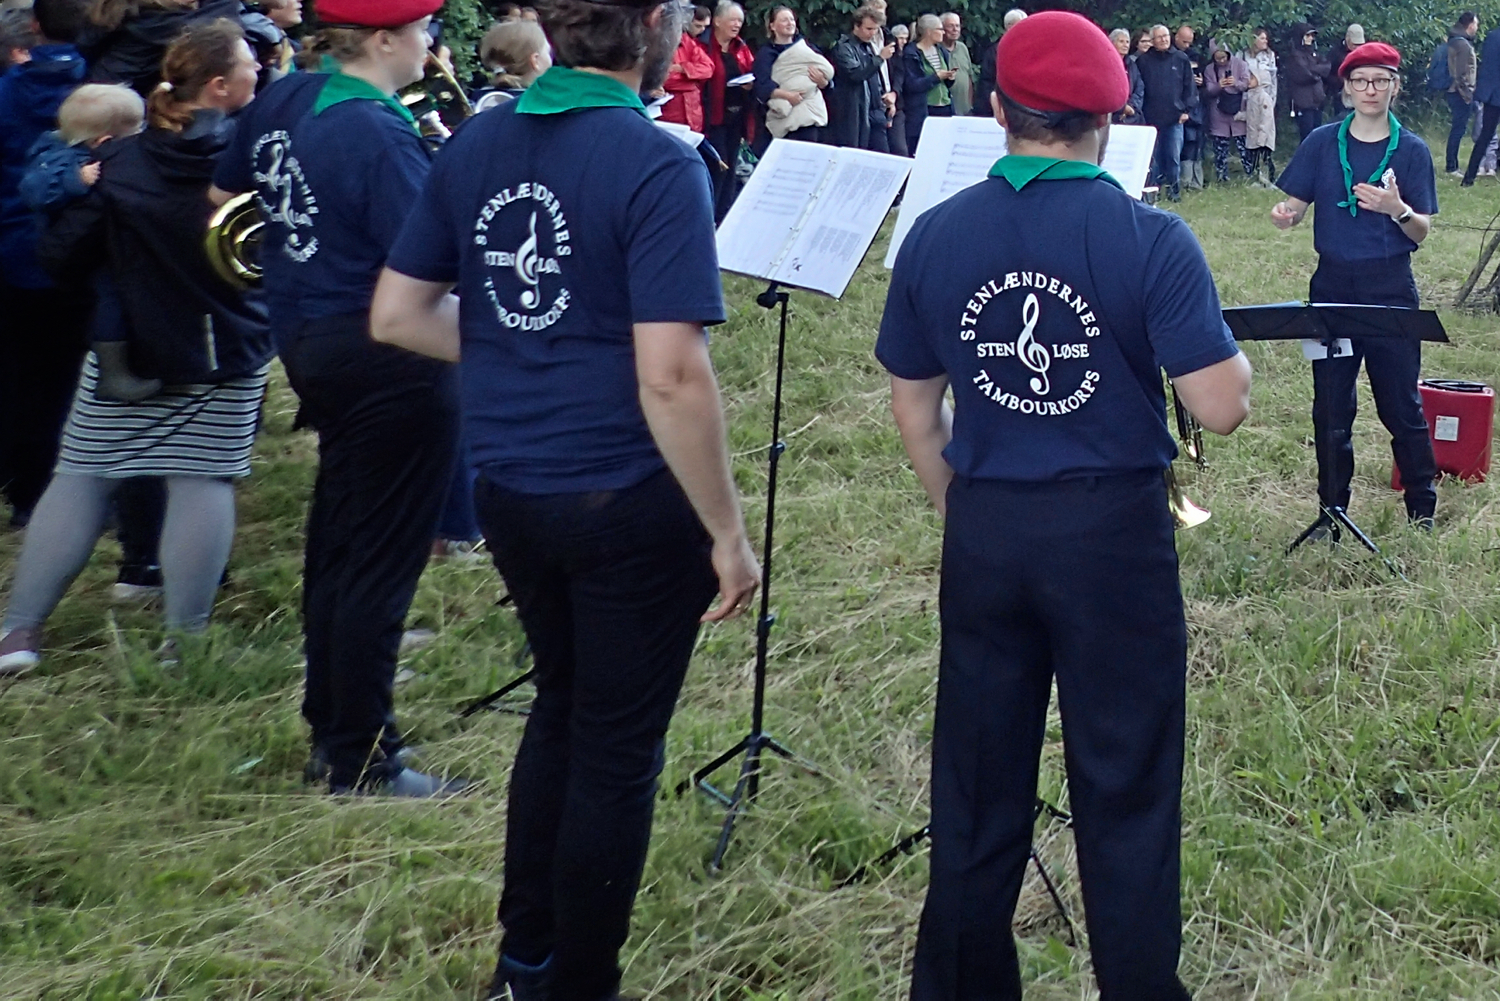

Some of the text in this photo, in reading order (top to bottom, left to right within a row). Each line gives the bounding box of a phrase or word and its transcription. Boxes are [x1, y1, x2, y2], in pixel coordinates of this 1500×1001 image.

[960, 271, 1101, 341] STENLÆNDERNES
[977, 341, 1090, 360] STEN LØSE
[972, 369, 1101, 416] TAMBOURKORPS
